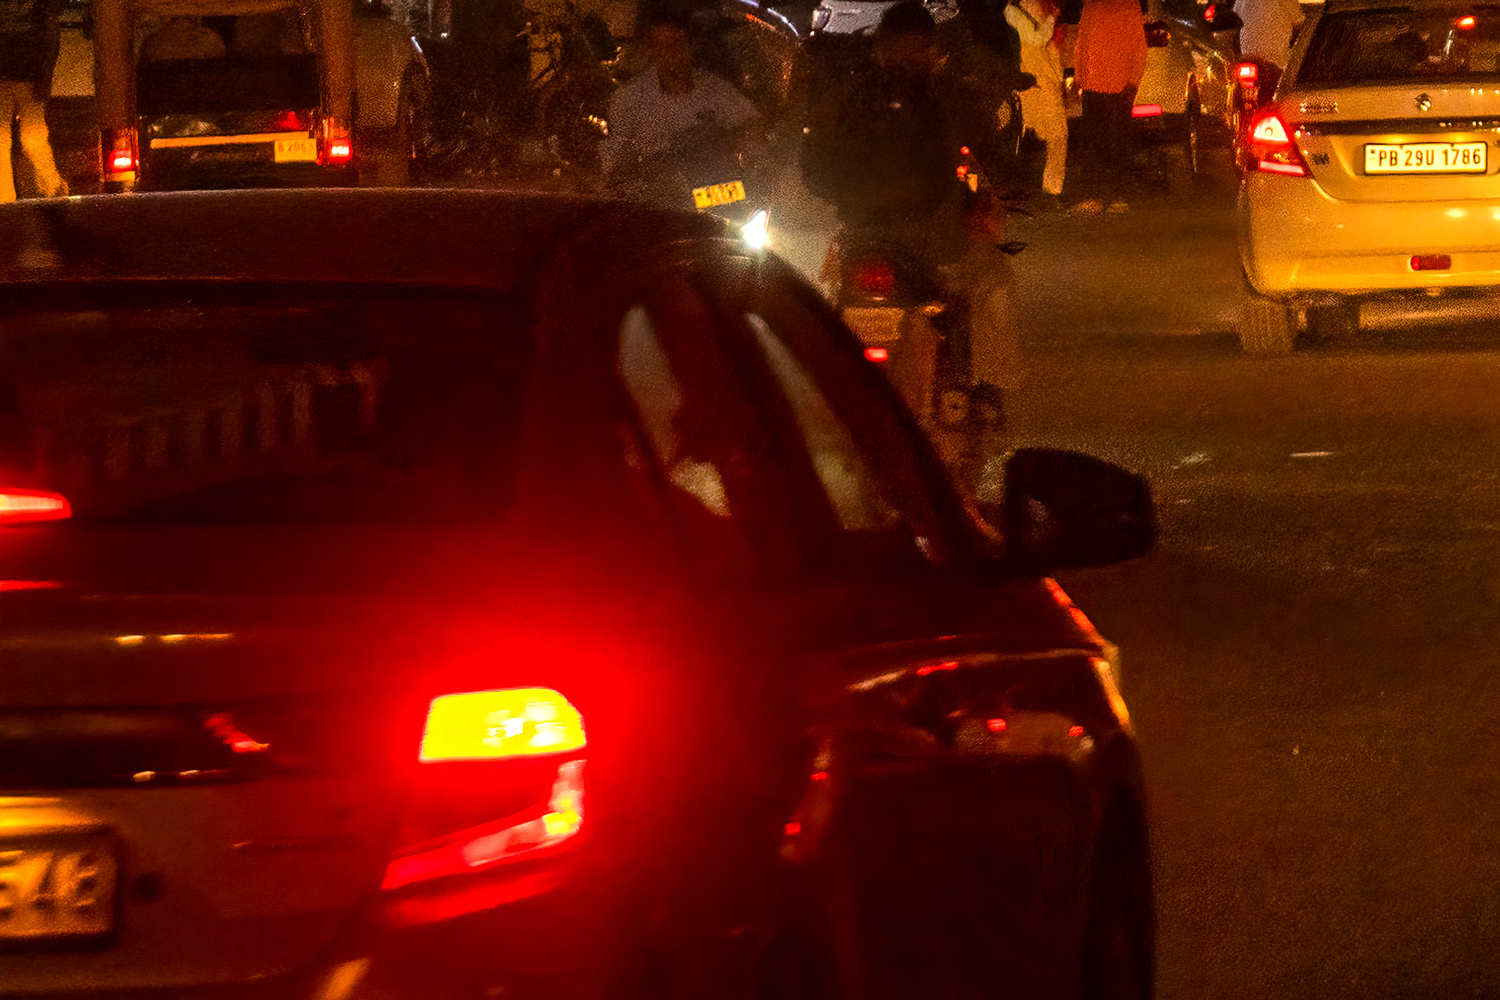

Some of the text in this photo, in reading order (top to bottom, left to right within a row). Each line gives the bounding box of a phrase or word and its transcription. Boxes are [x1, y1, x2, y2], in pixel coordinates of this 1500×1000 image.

[1378, 148, 1481, 167] PB 29U 1786
